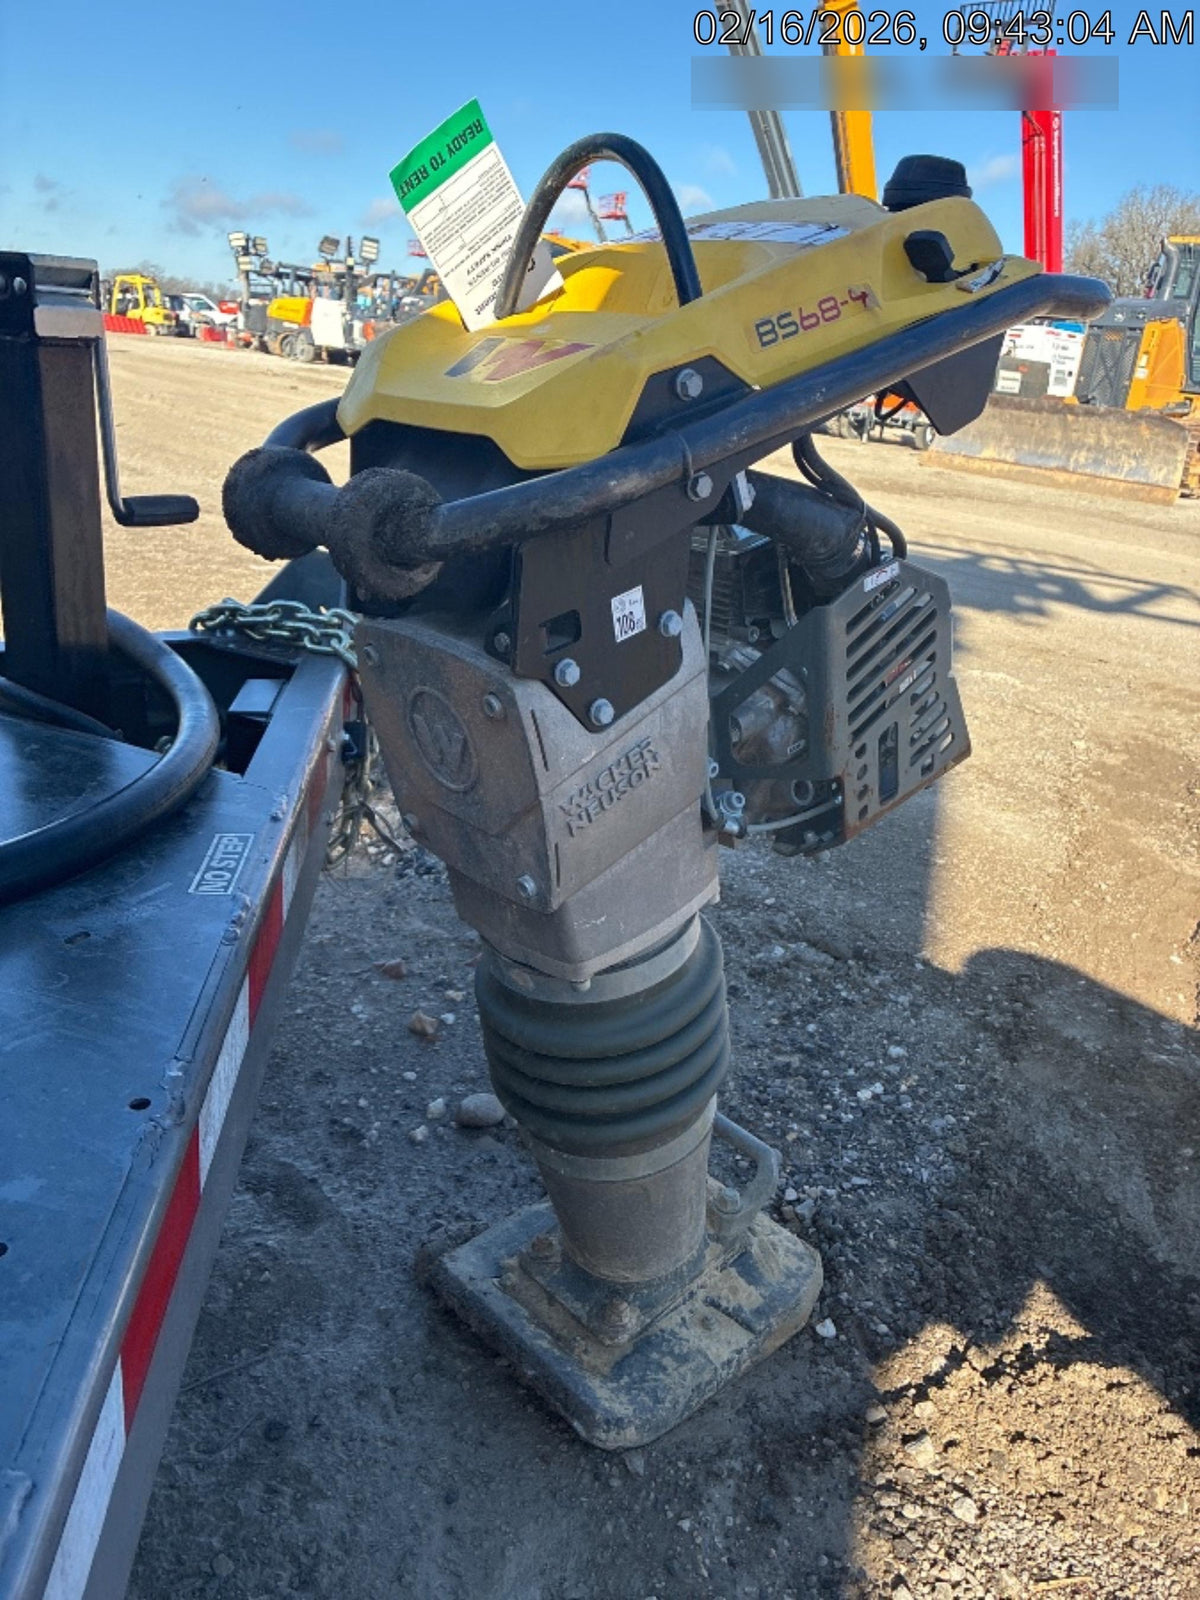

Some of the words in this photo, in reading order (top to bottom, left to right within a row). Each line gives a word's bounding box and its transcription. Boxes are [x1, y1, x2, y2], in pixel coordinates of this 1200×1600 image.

[445, 118, 484, 158] READY
[429, 151, 447, 172] TO
[398, 164, 430, 200] RENT
[755, 287, 869, 347] BS68-4
[558, 736, 659, 817] WACKER
[566, 751, 661, 838] NEUSON
[210, 836, 244, 869] STEP
[198, 870, 232, 892] NO
